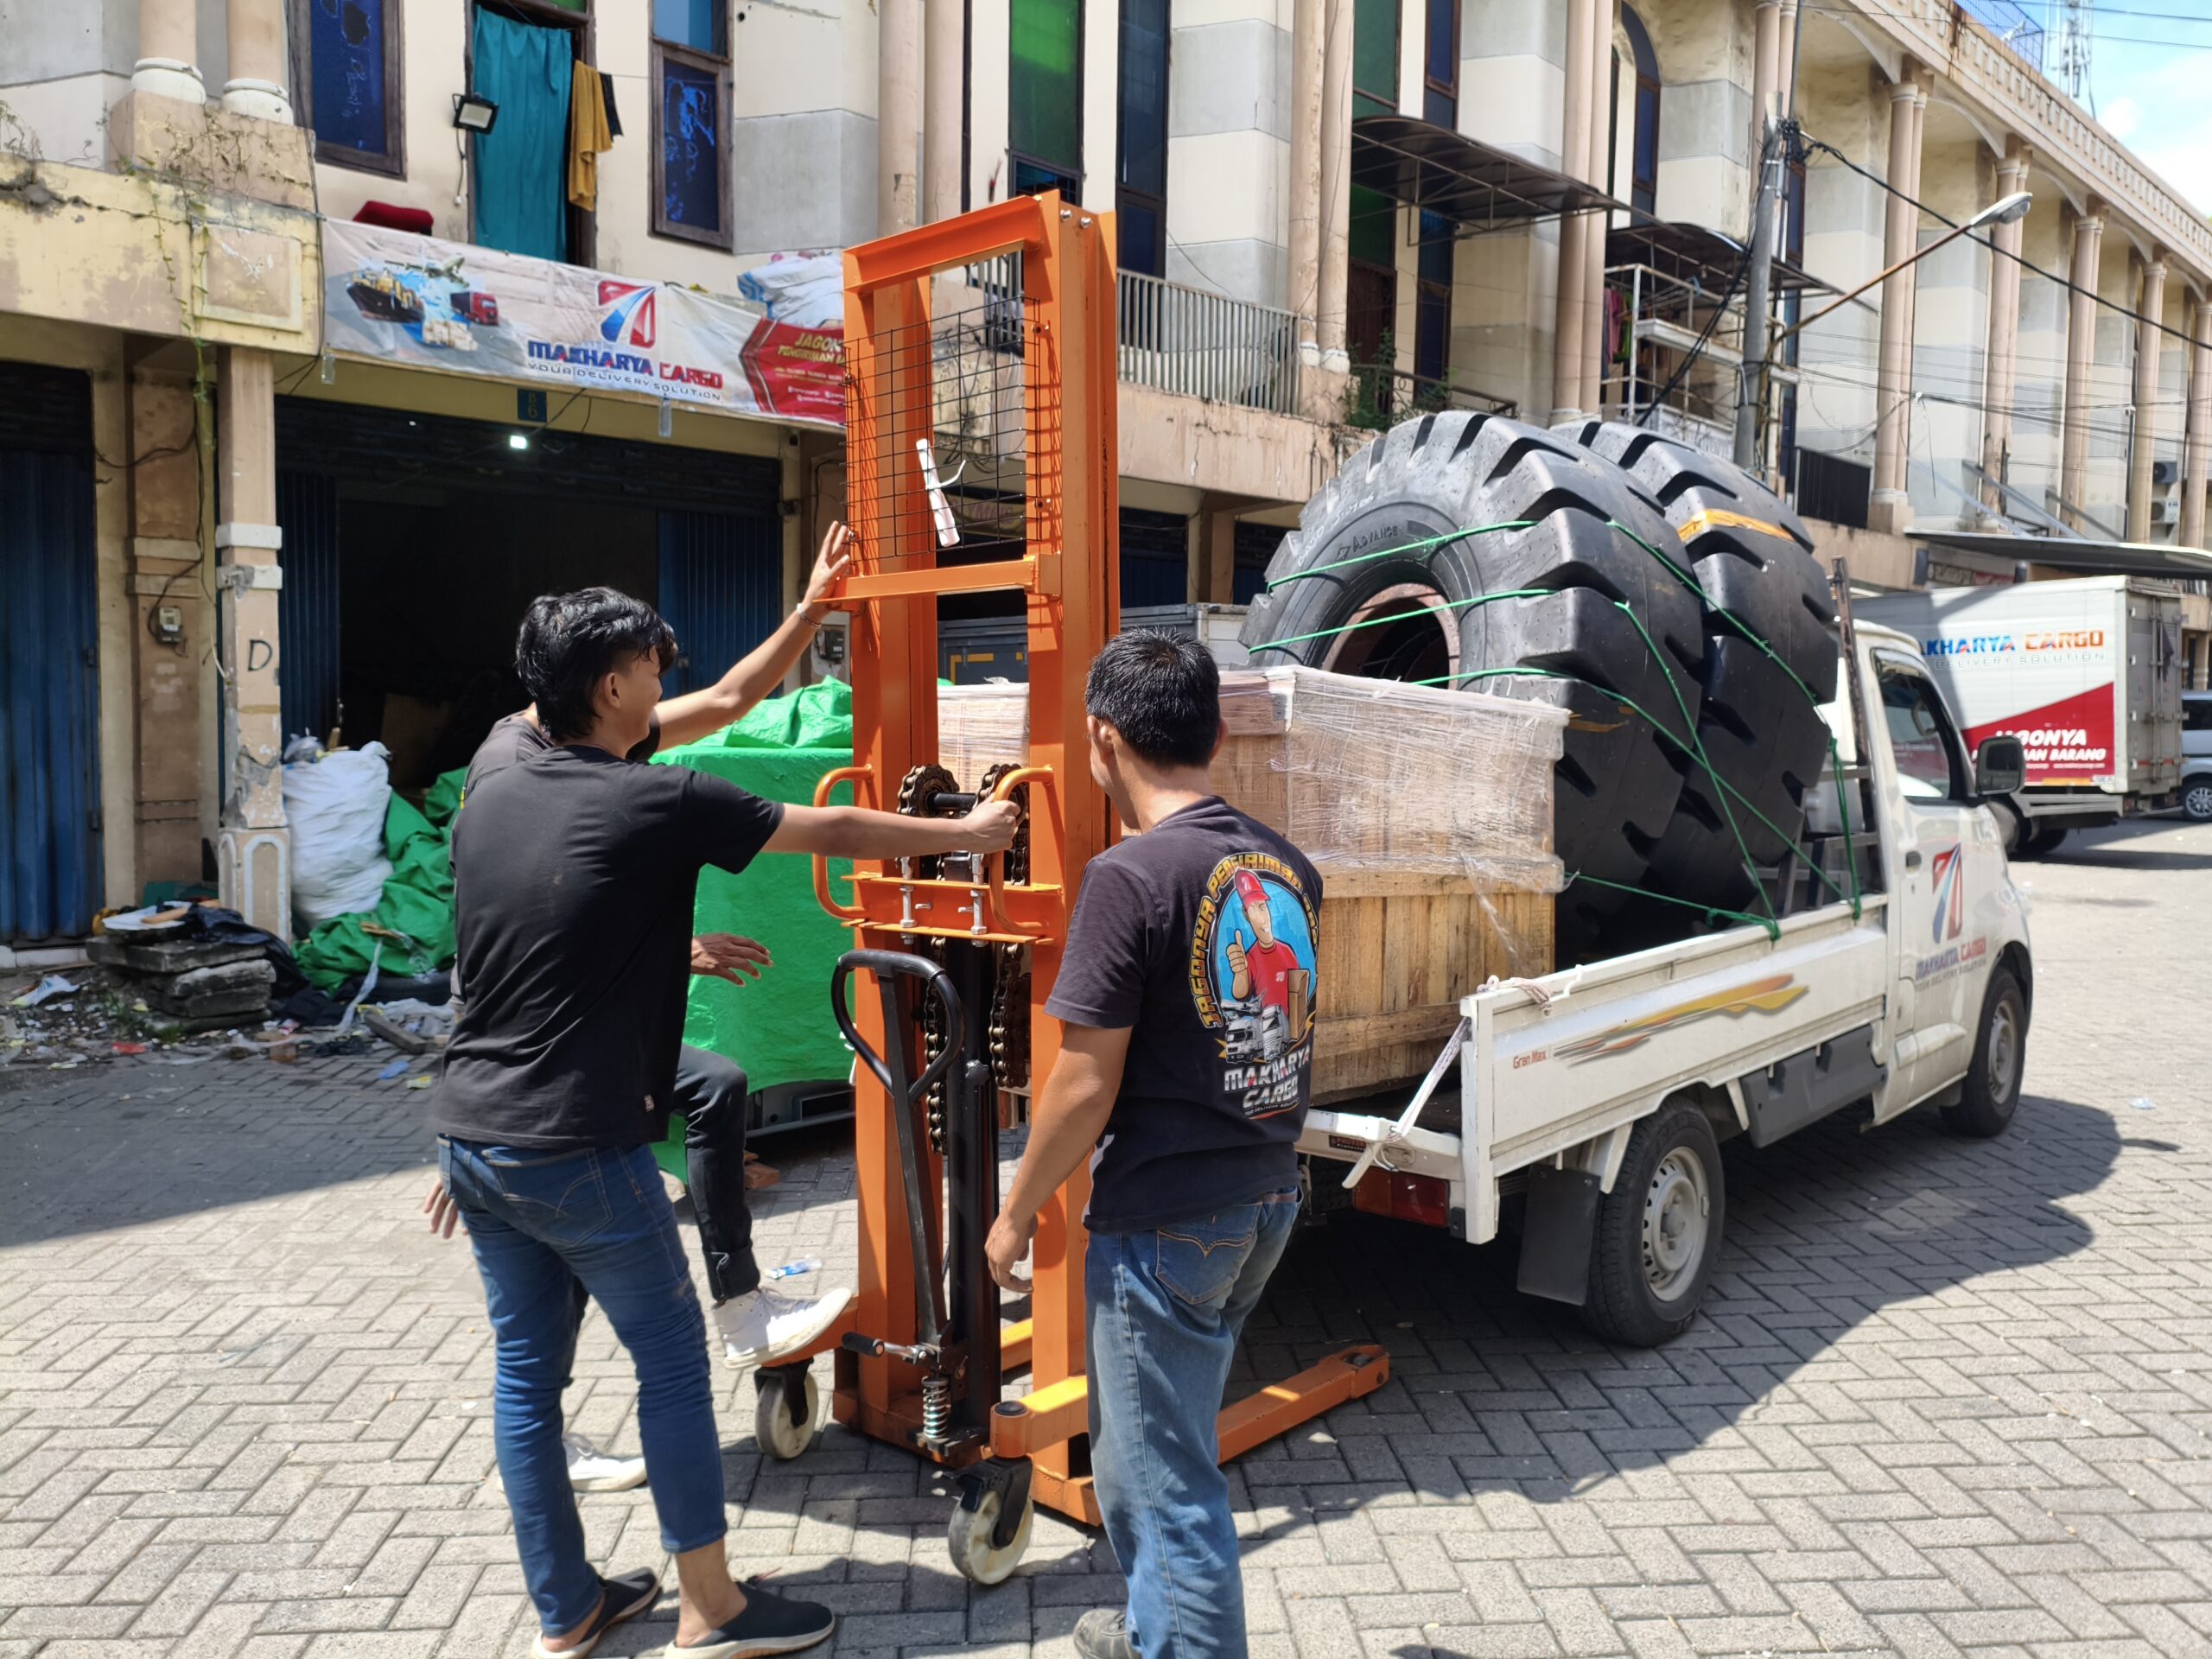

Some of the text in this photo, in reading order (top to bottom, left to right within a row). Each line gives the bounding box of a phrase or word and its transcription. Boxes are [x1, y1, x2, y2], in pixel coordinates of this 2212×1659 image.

[795, 333, 845, 353] JAGON
[528, 340, 723, 389] MAKHARYA CARGO
[529, 362, 721, 401] YOUR DELIVERY SOLUTION
[248, 639, 273, 671] D
[2024, 630, 2104, 651] CARGO
[2019, 652, 2105, 664] SOLUTION
[2050, 748, 2107, 761] BARANG
[1189, 895, 1223, 1028] JAGONYA
[1224, 1045, 1310, 1091] MAKHARYA
[1513, 1054, 1530, 1070] Gran
[1243, 1075, 1299, 1109] CARGO
